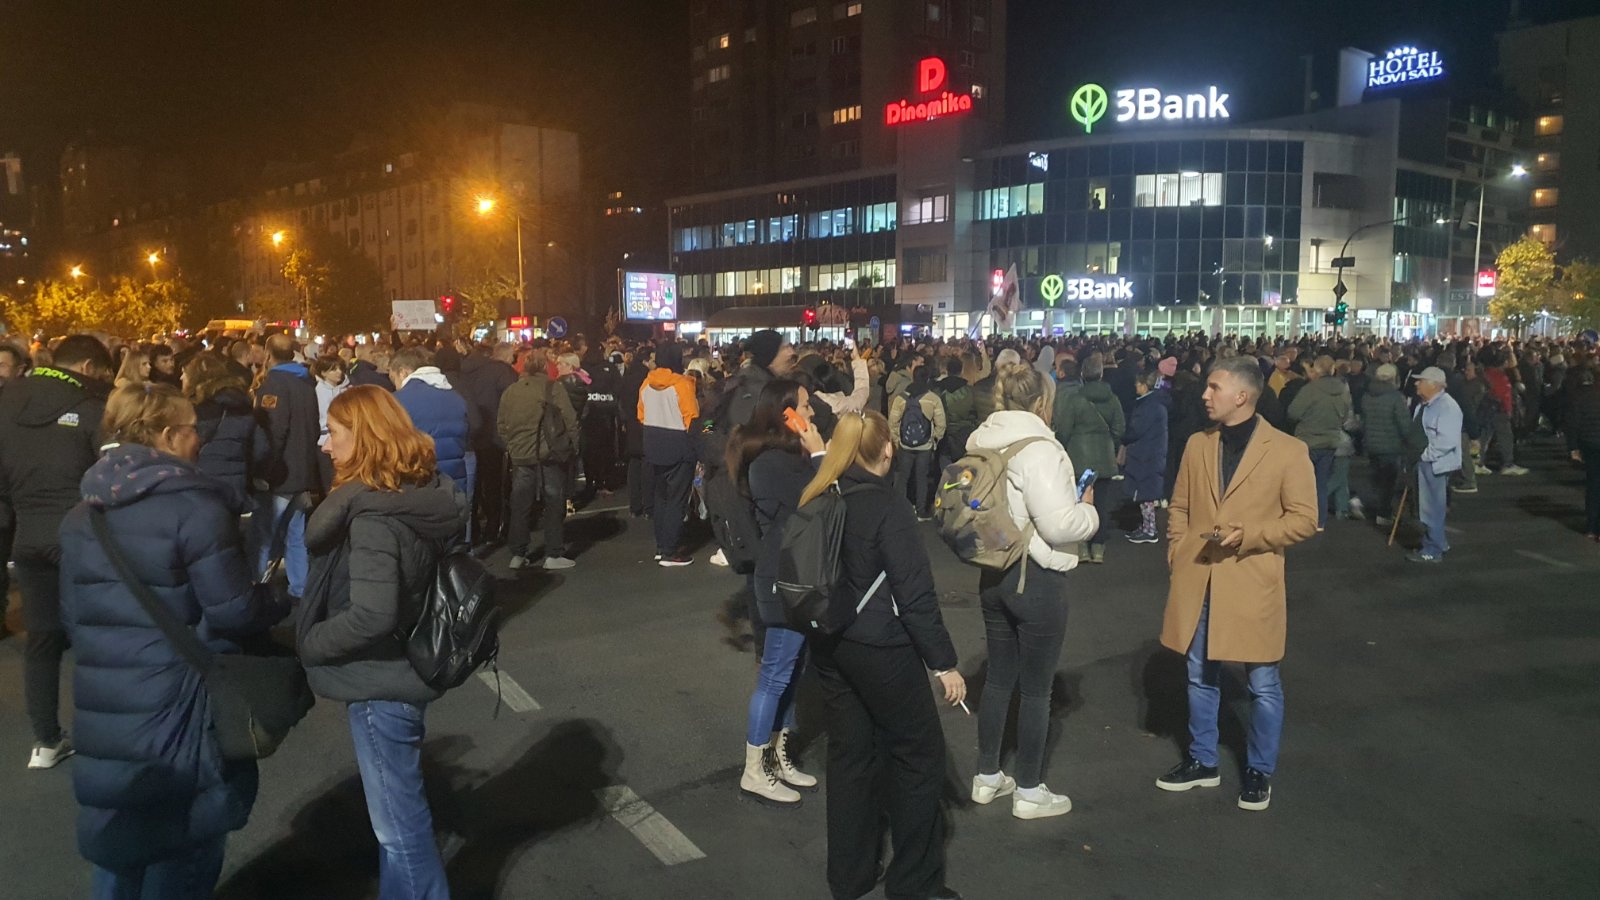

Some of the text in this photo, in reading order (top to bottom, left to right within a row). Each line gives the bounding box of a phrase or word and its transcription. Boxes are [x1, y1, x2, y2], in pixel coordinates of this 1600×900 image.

[920, 57, 945, 92] D
[1369, 51, 1442, 76] HOTEL
[1369, 67, 1443, 86] NOVI SAD
[886, 92, 971, 125] Dinamika
[1116, 86, 1230, 121] 3Bank
[1067, 277, 1133, 300] 3Bank
